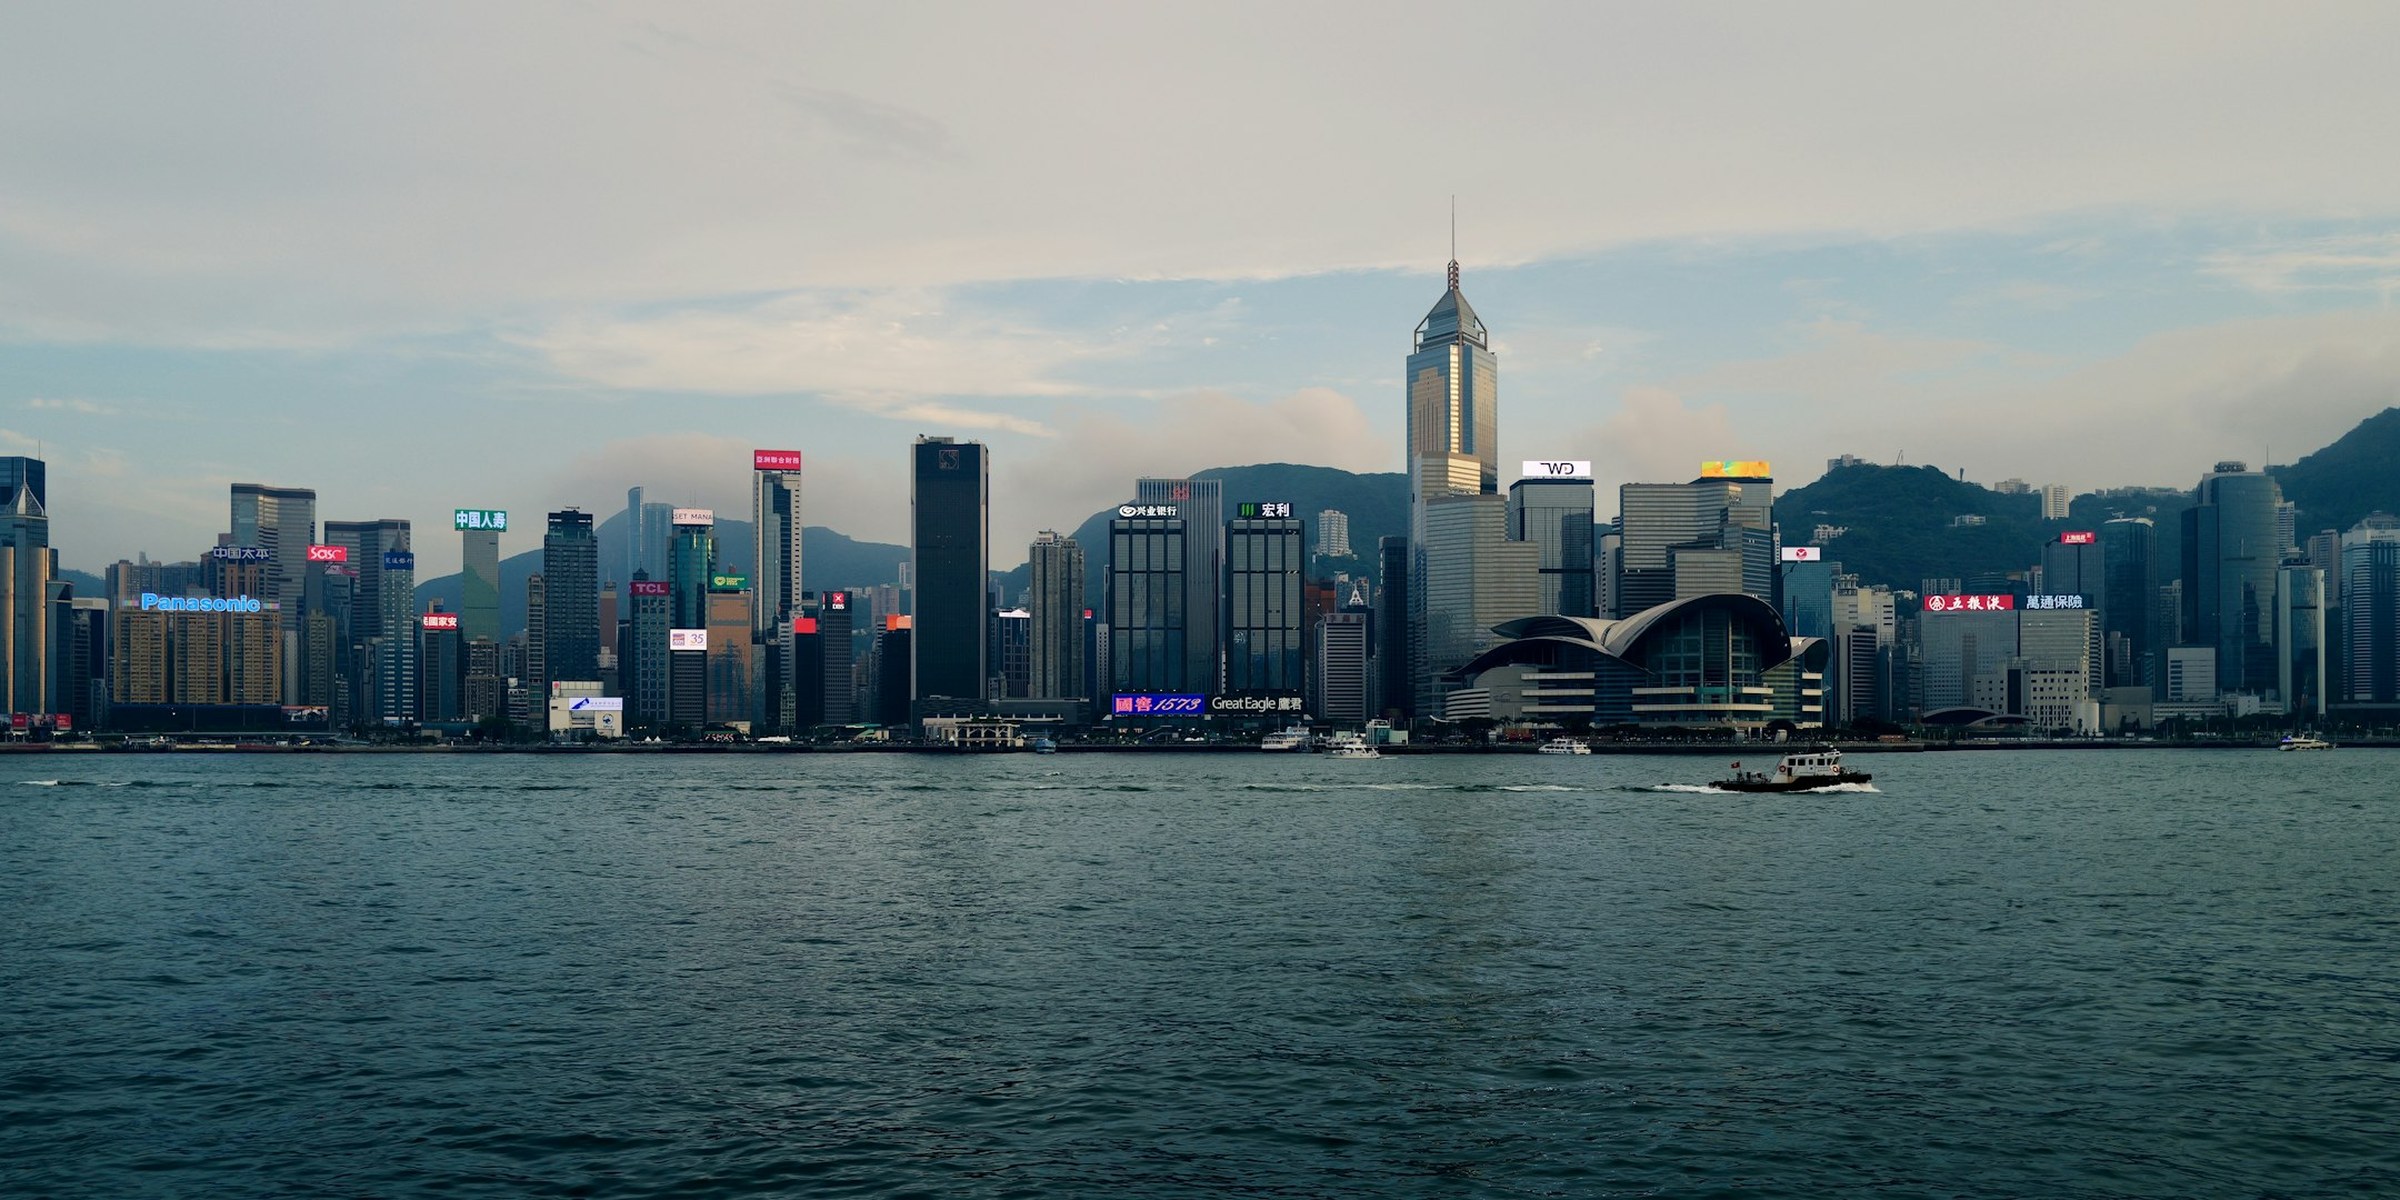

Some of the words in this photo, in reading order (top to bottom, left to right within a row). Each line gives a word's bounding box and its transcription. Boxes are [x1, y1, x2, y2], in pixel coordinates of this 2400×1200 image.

[1136, 505, 1177, 516] 兴业银行
[1262, 503, 1290, 517] 宏利
[213, 547, 270, 560] 中国太平
[636, 583, 666, 593] TCL
[141, 593, 261, 612] Panasonic
[2026, 594, 2083, 609] 萬通保險
[690, 633, 704, 644] 35
[1212, 697, 1244, 710] Great
[1245, 696, 1276, 713] Eagle
[1277, 697, 1303, 711] 鷹君
